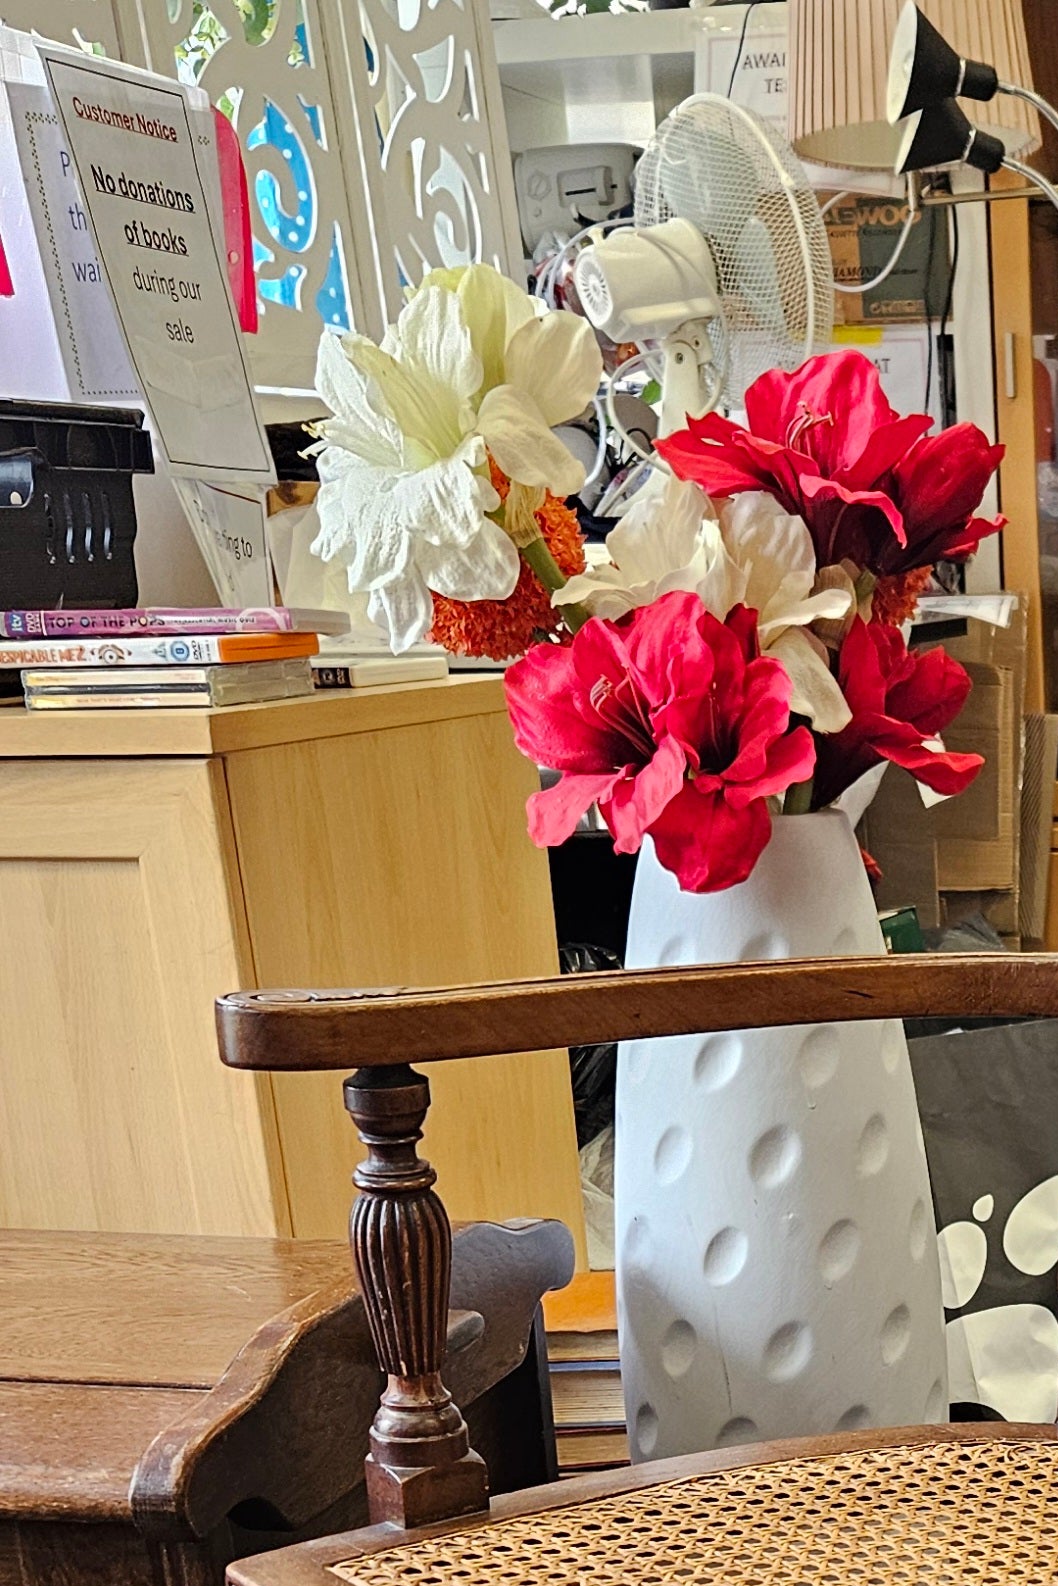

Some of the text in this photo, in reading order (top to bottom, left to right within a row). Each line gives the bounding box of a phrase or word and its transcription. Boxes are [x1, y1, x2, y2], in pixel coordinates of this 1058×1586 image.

[72, 96, 178, 143] Customer Notice
[90, 165, 195, 213] No donations
[124, 220, 188, 255] of books
[132, 266, 202, 303] during our
[165, 319, 195, 345] sale
[240, 536, 253, 558] to
[48, 616, 75, 628] TOP
[80, 616, 97, 628] OF
[102, 616, 126, 628] THE
[129, 615, 166, 627] POPS
[0, 648, 58, 663] ESPICABLE
